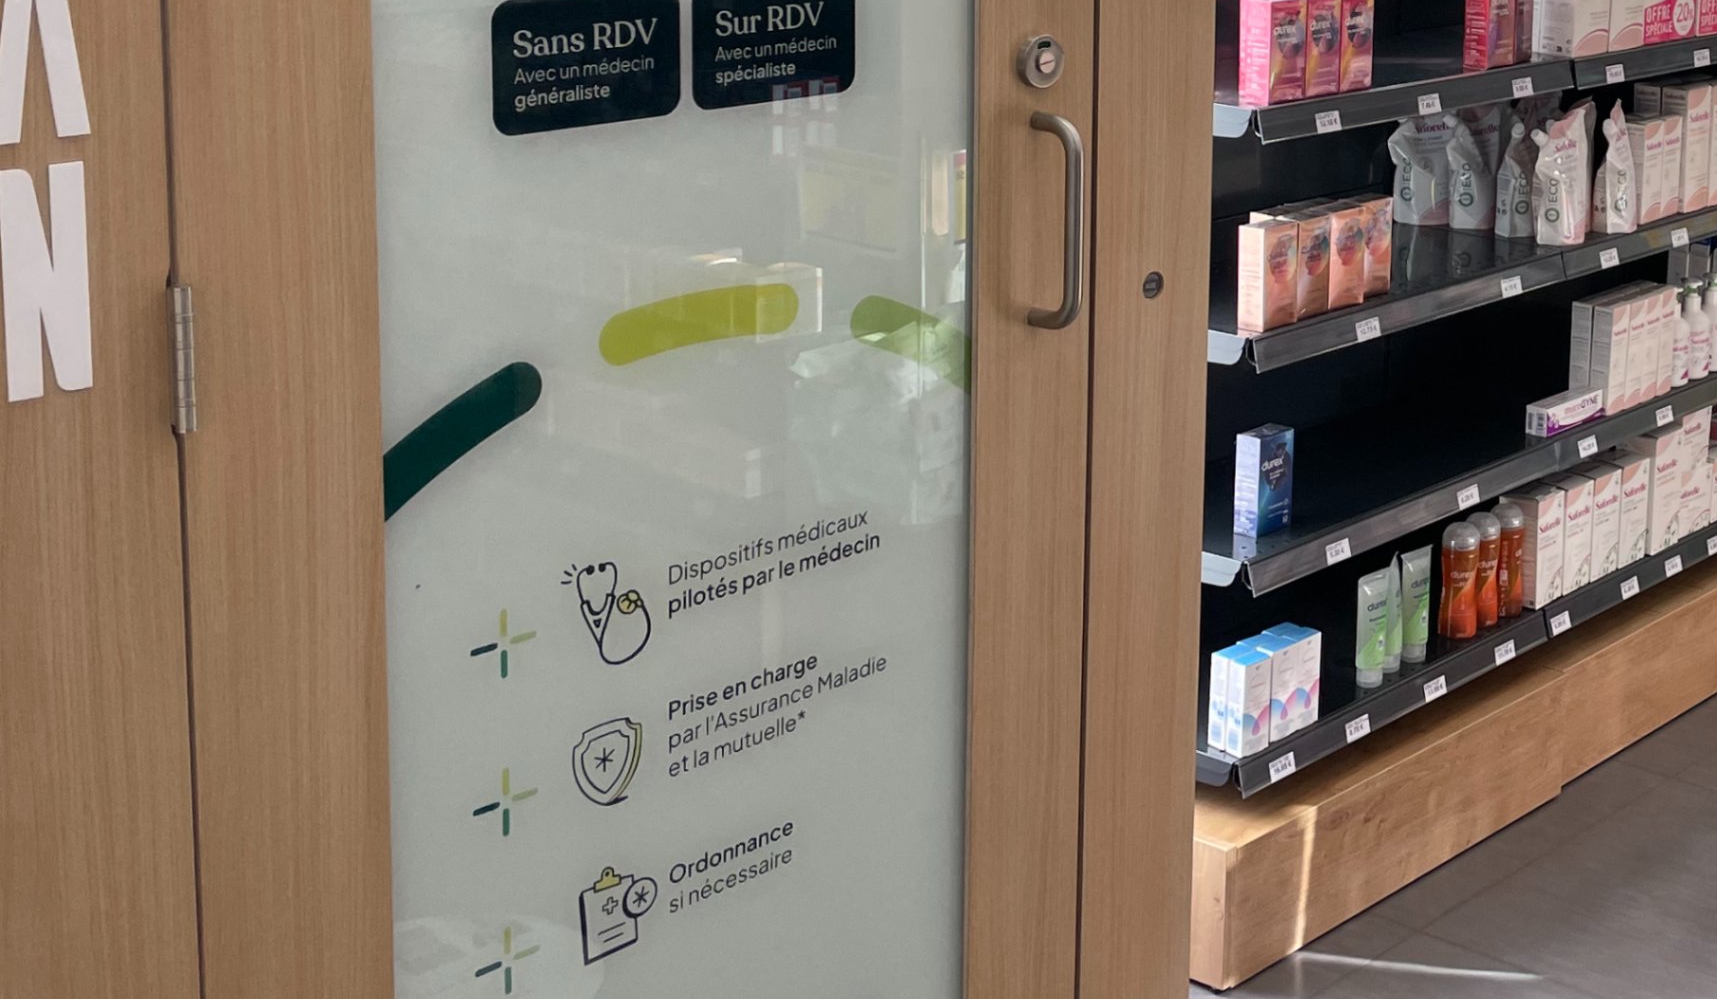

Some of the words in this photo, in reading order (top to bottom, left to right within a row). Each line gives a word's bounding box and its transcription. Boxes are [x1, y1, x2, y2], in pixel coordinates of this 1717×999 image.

[513, 28, 585, 58] Sans
[593, 18, 658, 50] RDV
[715, 10, 761, 37] Sur
[767, 1, 824, 31] RDV
[715, 45, 752, 62] Avec
[754, 43, 772, 57] un
[775, 34, 837, 56] médecin
[514, 65, 557, 85] Avec
[560, 63, 580, 79] un
[585, 55, 654, 78] médecin
[715, 61, 796, 85] spécialiste
[514, 83, 611, 111] généraliste
[668, 537, 774, 585] Dispositifs
[778, 510, 869, 553] médicaux
[668, 579, 738, 619] pilotés
[741, 567, 775, 596] par
[778, 559, 795, 579] le
[799, 532, 881, 572] médecin
[668, 689, 718, 721] Prise
[722, 681, 747, 702] en
[750, 654, 818, 691] charge
[668, 724, 702, 753] par
[706, 683, 814, 736] l'Assurance
[817, 654, 887, 694] Maladie
[668, 757, 690, 778] et
[692, 747, 710, 769] la
[669, 820, 794, 885] Ordonnance
[669, 891, 685, 913] si
[688, 848, 793, 905] nécessaire
